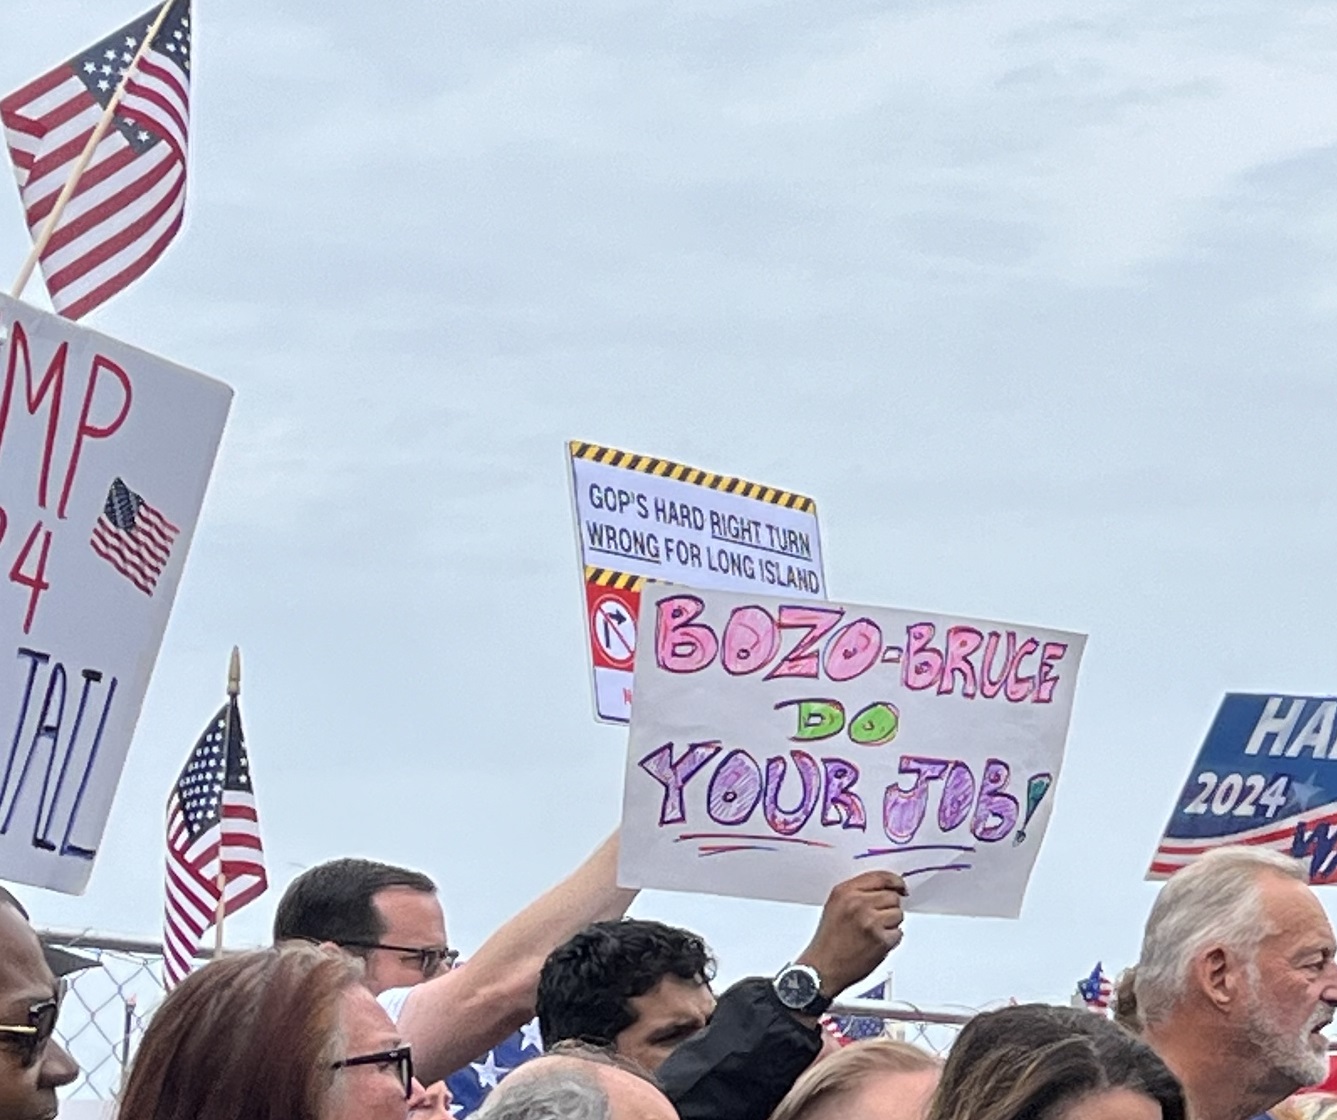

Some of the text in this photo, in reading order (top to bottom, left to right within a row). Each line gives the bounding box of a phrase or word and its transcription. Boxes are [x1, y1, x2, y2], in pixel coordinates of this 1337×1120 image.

[589, 483, 811, 557] GOP'S HARD RIGHT TURN
[0, 506, 53, 634] 4
[587, 521, 820, 594] WRONG FOR LONG ISLAND
[656, 595, 1067, 703] BOZO-BRUCE
[774, 698, 899, 745] DO
[638, 741, 1052, 847] YOUR JOB!
[1183, 771, 1291, 819] 2024
